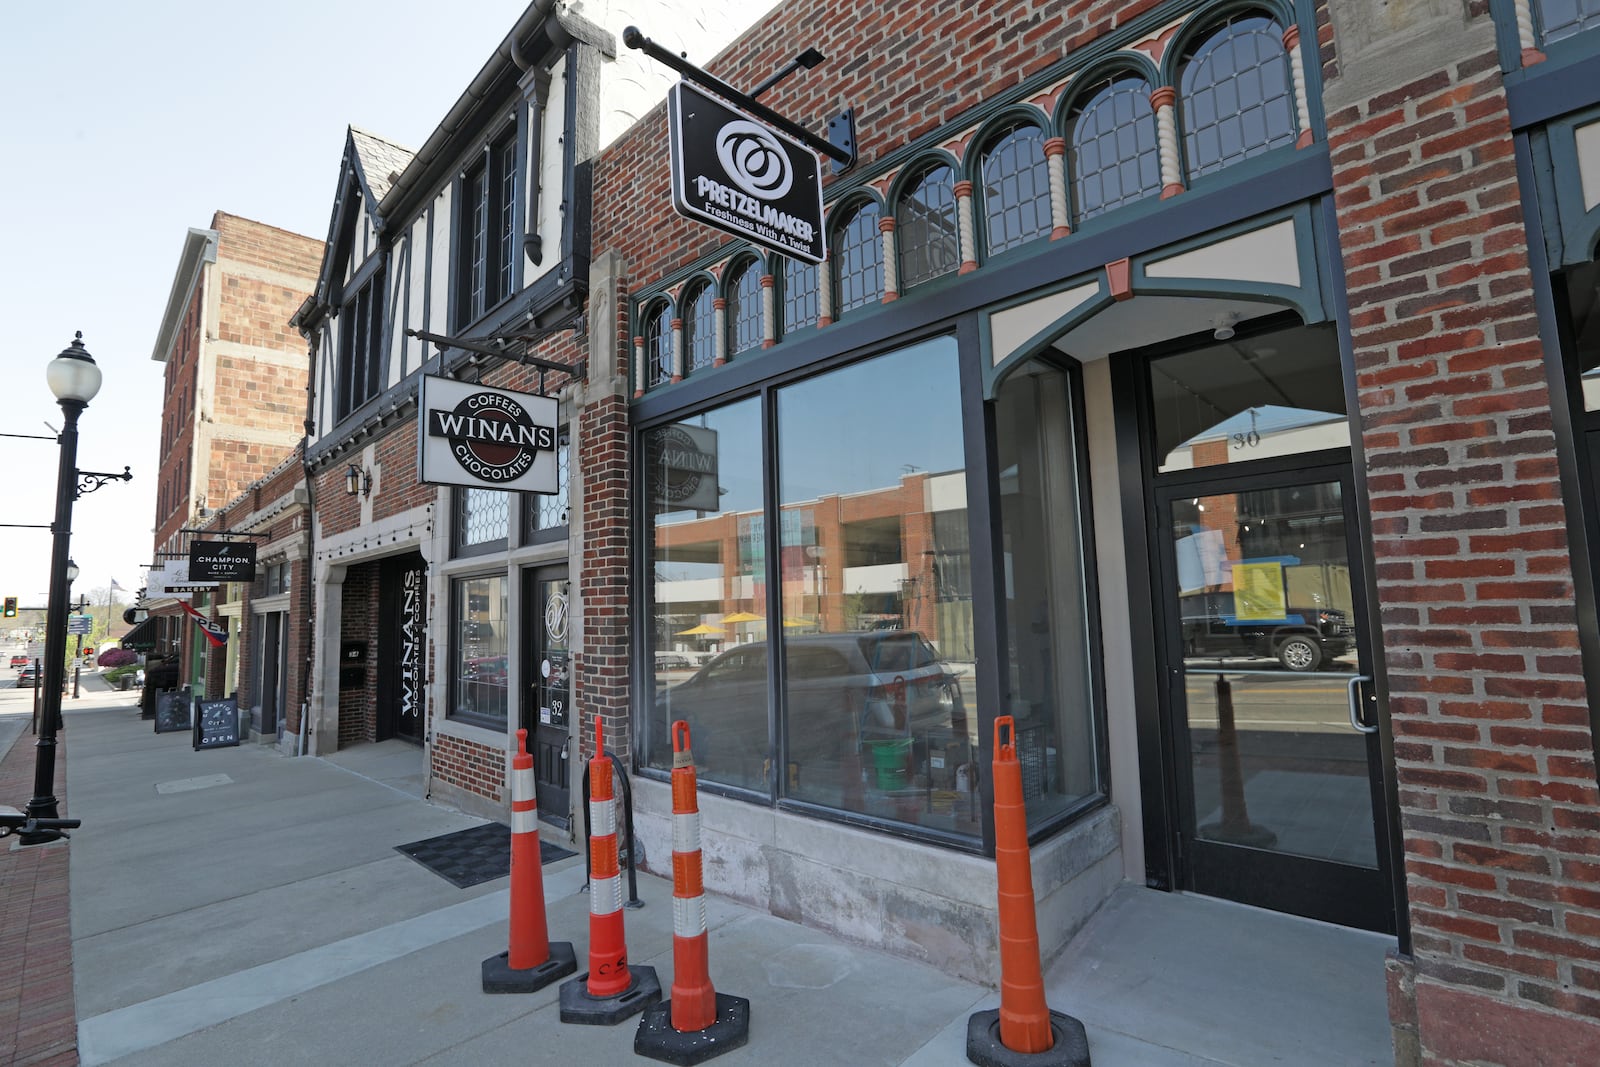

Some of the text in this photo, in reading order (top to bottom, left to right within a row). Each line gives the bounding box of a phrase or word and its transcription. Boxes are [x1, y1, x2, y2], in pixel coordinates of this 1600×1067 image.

[697, 175, 813, 242] PRETZELMAKER
[705, 201, 811, 253] Freshness With A Twist
[468, 395, 522, 417] COFFEES
[437, 412, 551, 448] WINANS
[1233, 431, 1260, 449] 30
[456, 445, 532, 479] CHOCOLATES
[402, 570, 415, 715] WINANS
[552, 700, 562, 716] 32
[202, 735, 233, 743] OPEN
